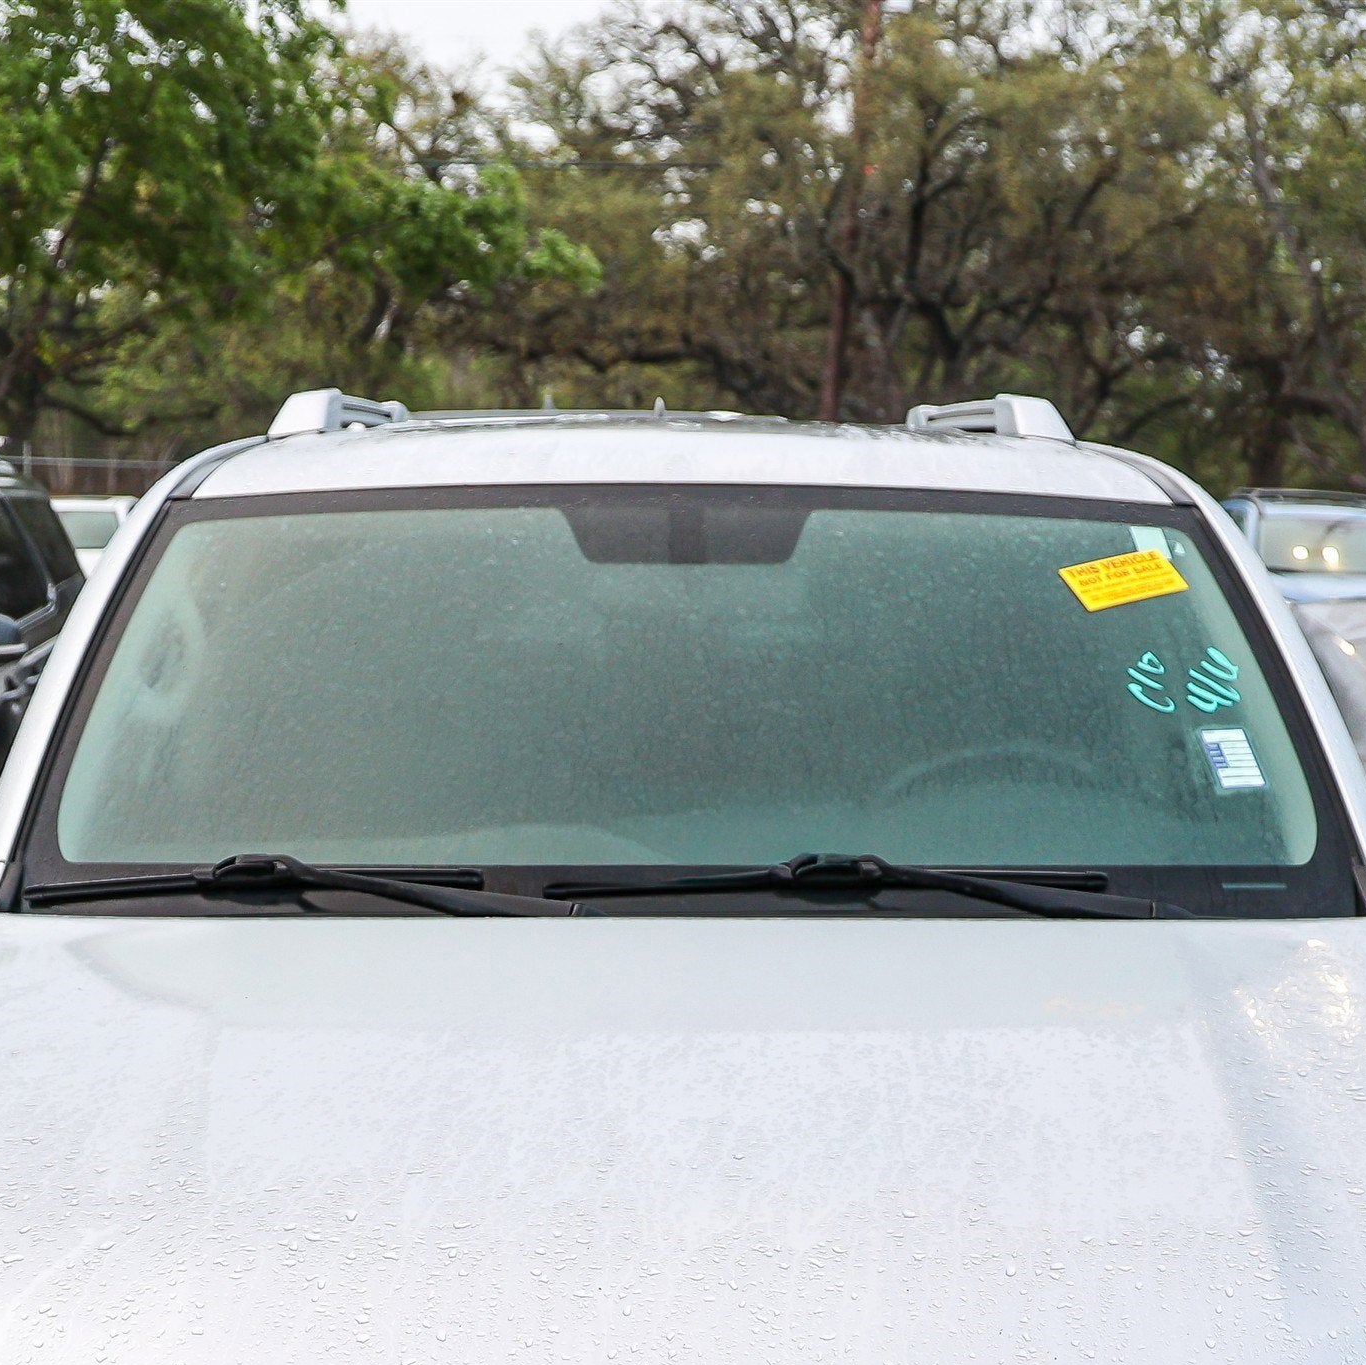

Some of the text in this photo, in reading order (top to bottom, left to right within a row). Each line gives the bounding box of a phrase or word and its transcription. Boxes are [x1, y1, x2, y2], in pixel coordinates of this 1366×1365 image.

[1066, 550, 1160, 578] THIS VEHICLE
[1078, 575, 1104, 587] NOT
[1105, 569, 1131, 581] FOR
[1133, 562, 1164, 575] SALE
